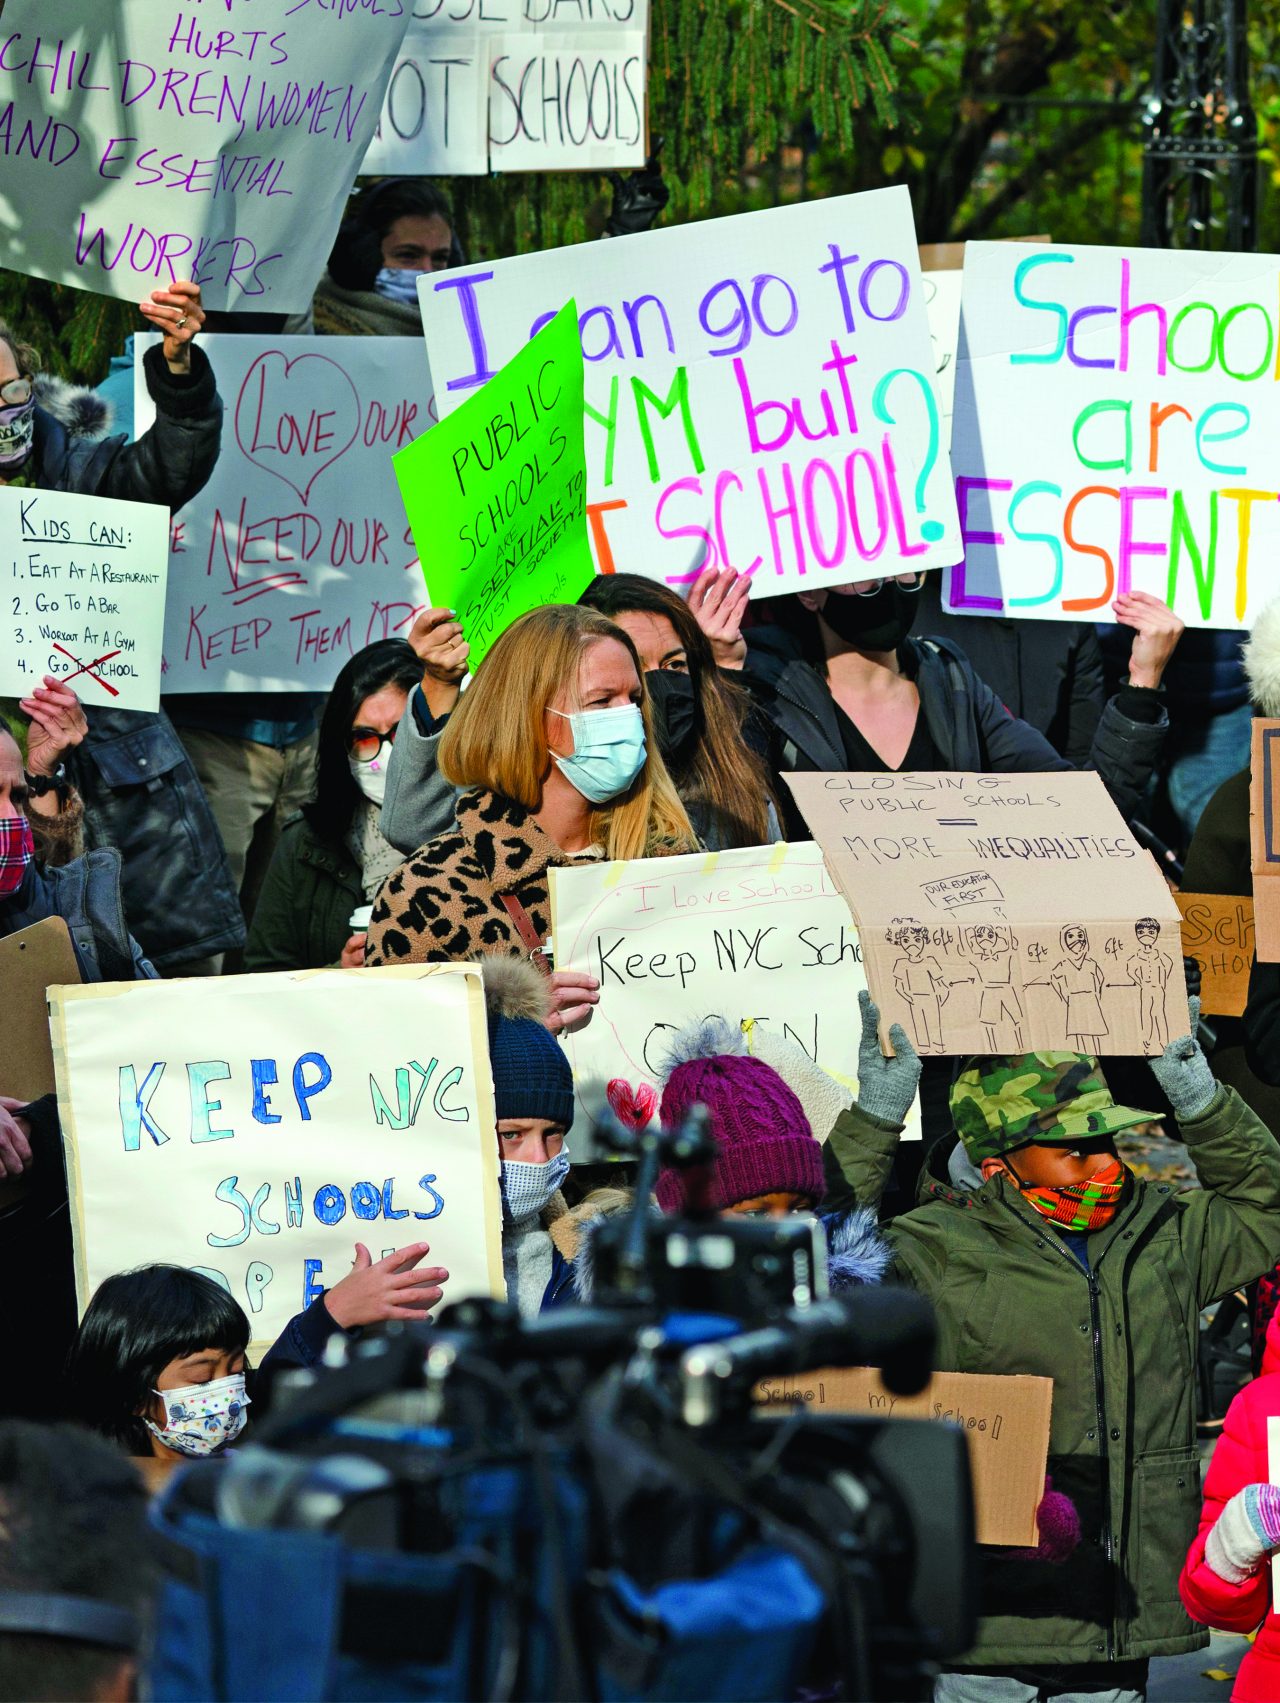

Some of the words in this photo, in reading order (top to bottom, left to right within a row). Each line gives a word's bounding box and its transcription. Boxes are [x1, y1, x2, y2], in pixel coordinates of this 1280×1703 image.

[169, 14, 288, 65] HURTS
[256, 80, 366, 142] WOMEN
[488, 56, 640, 145] SCHOOLS
[0, 102, 80, 166] AND
[99, 138, 293, 199] ESSENTIAL
[434, 271, 500, 391] I
[699, 273, 799, 357] go
[818, 244, 911, 334] to
[251, 363, 336, 456] LOVE
[363, 399, 418, 448] OUR
[452, 360, 562, 496] PUBLIC
[734, 340, 858, 454] but
[1072, 400, 1250, 475] are
[20, 498, 71, 537] KIDS
[460, 426, 567, 571] SCHOOLS
[207, 497, 322, 590] NEED
[331, 518, 388, 567] OUR
[457, 502, 563, 627] SSENTIAL
[496, 524, 519, 566] ARE
[526, 494, 583, 576] SOCIETY!
[90, 563, 100, 583] A
[102, 564, 160, 583] RESTAURANT
[185, 604, 272, 670] KEEP
[839, 797, 936, 813] PUBLIC
[963, 793, 1062, 808] SCHOOLS
[843, 836, 943, 864] MORE
[634, 886, 661, 913] I
[672, 885, 731, 909] Love
[740, 869, 826, 899] School
[925, 881, 950, 895] OUR
[943, 888, 988, 904] FIRST
[597, 936, 697, 988] Keep
[714, 926, 783, 972] NYC
[118, 1052, 332, 1152] KEEP
[369, 1057, 469, 1131] NYC
[206, 1173, 445, 1248] SCHOOLS
[759, 1380, 826, 1404] School
[868, 1392, 900, 1417] my
[933, 1402, 1003, 1440] School
